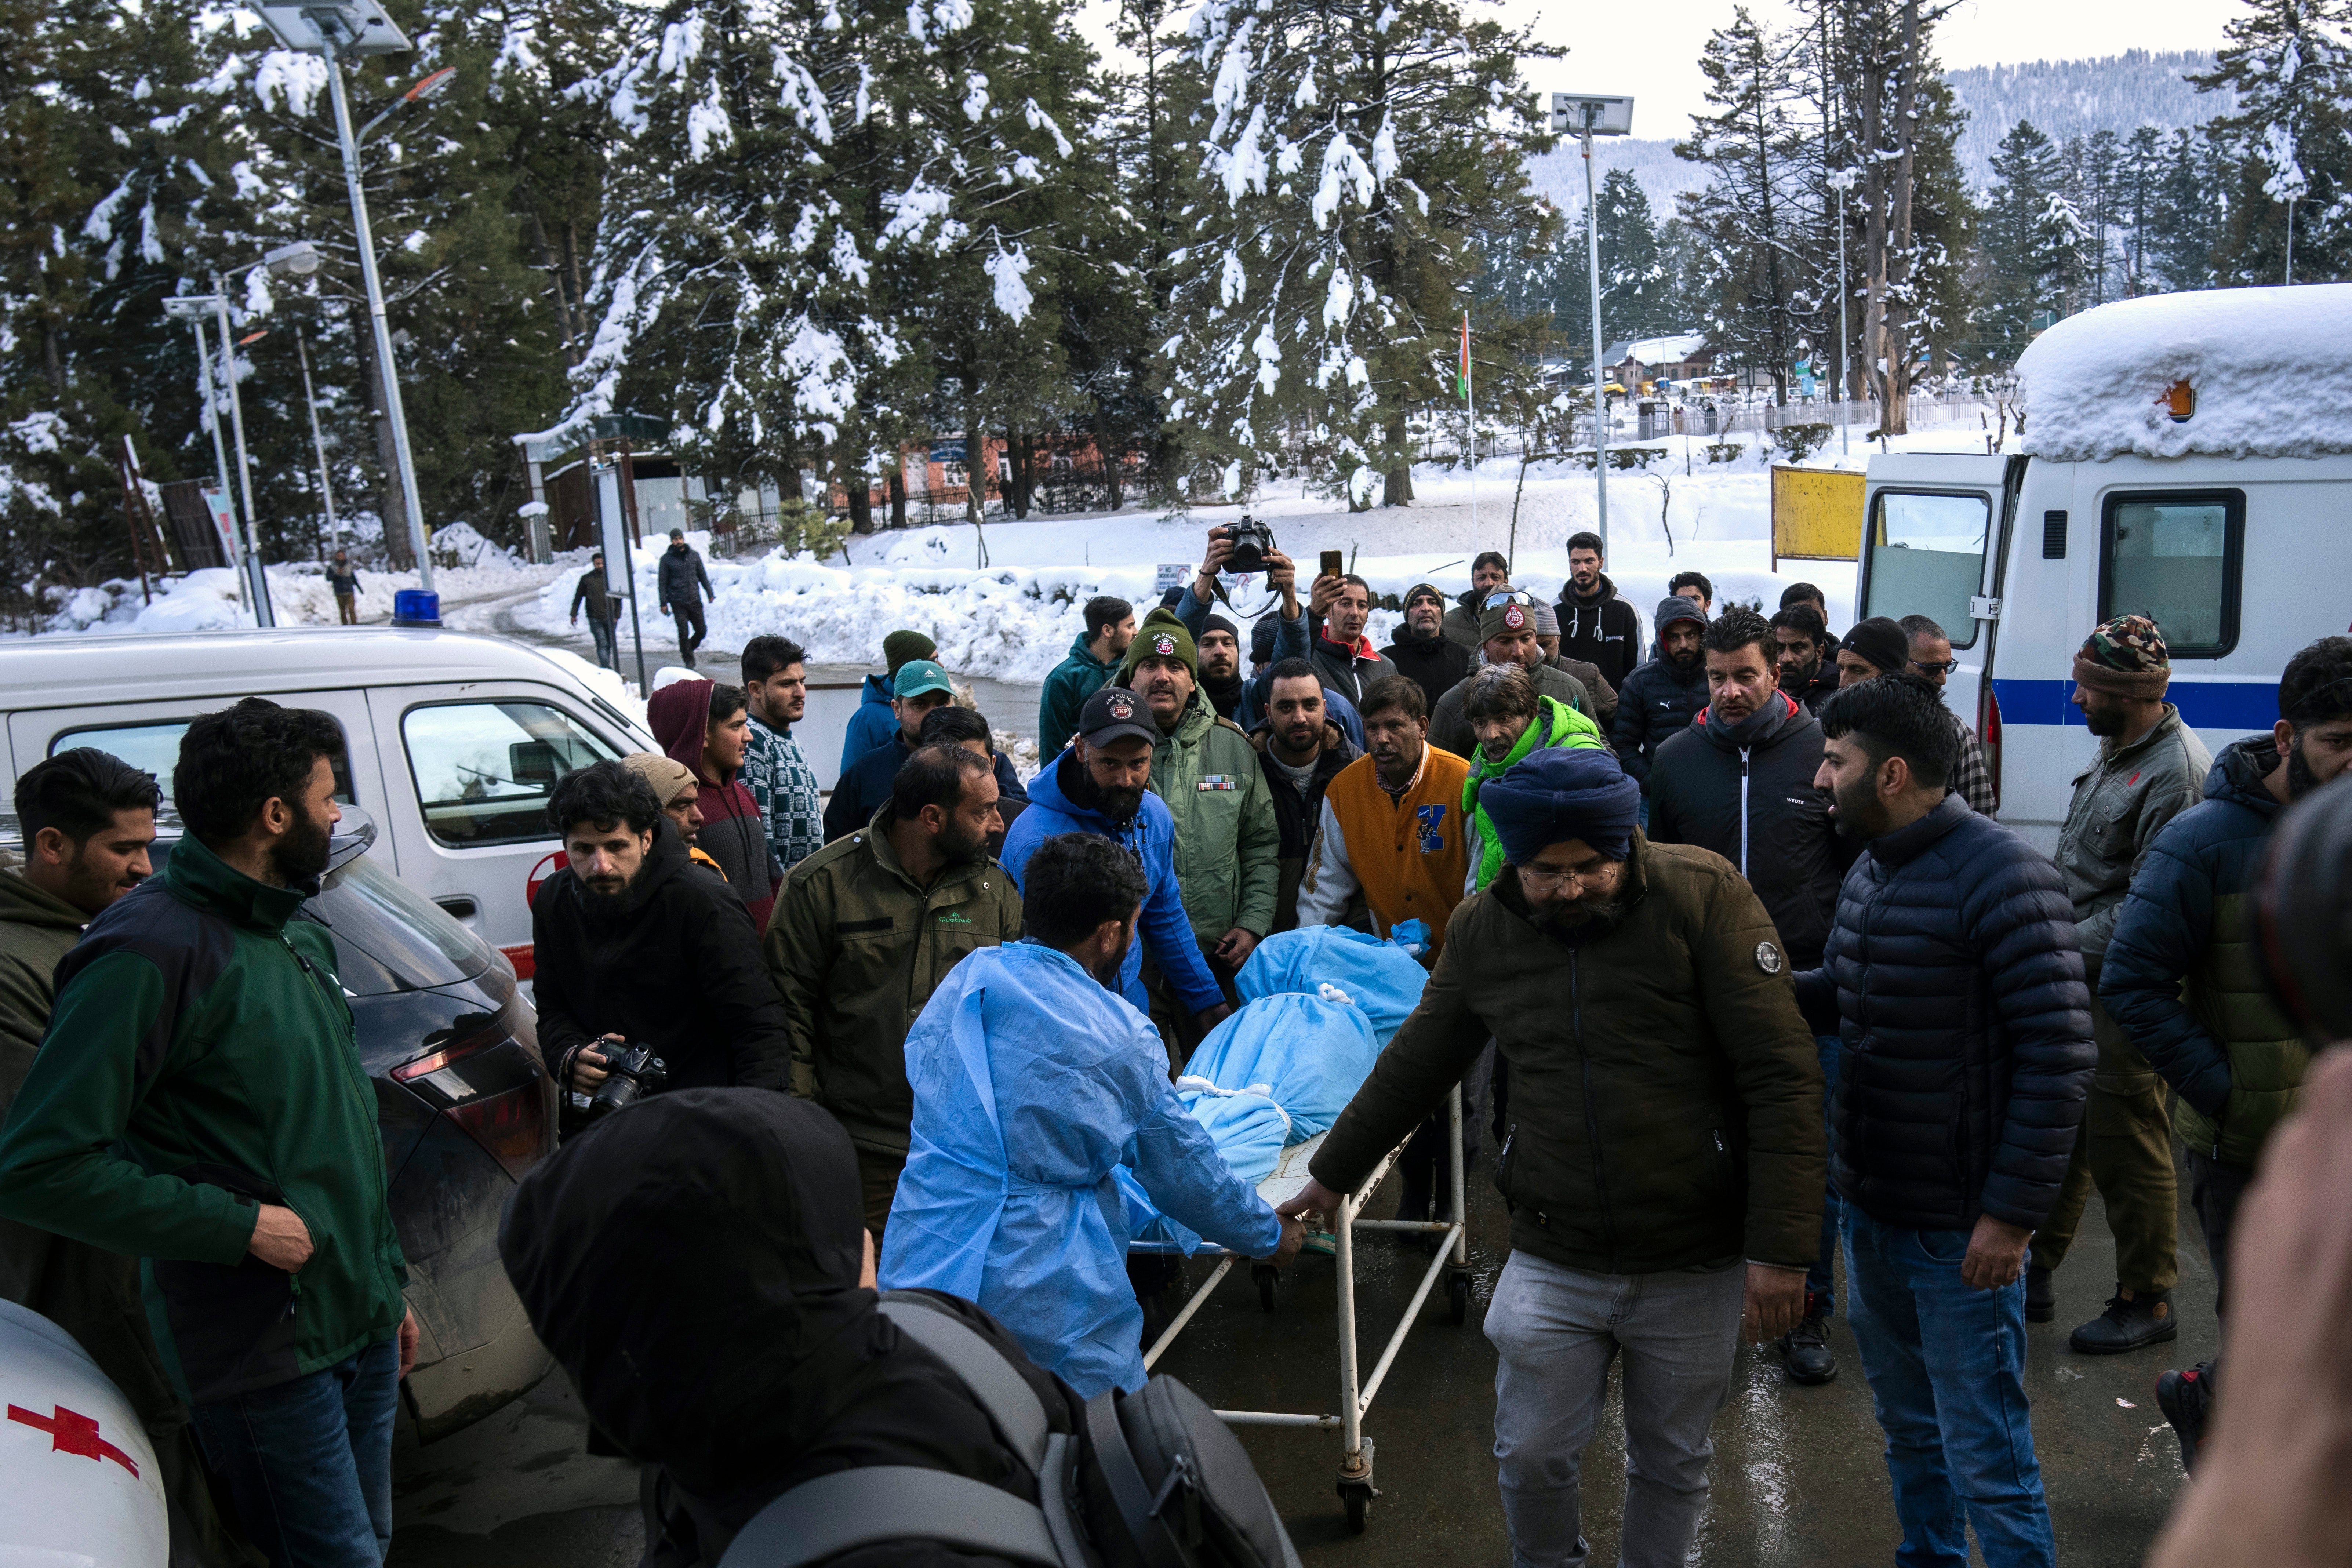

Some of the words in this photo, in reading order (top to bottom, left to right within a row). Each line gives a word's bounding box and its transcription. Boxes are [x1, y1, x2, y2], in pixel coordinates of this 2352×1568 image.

[1162, 633, 1179, 643] POLICE
[1105, 695, 1115, 705] J&K
[1116, 693, 1135, 704] POLICE
